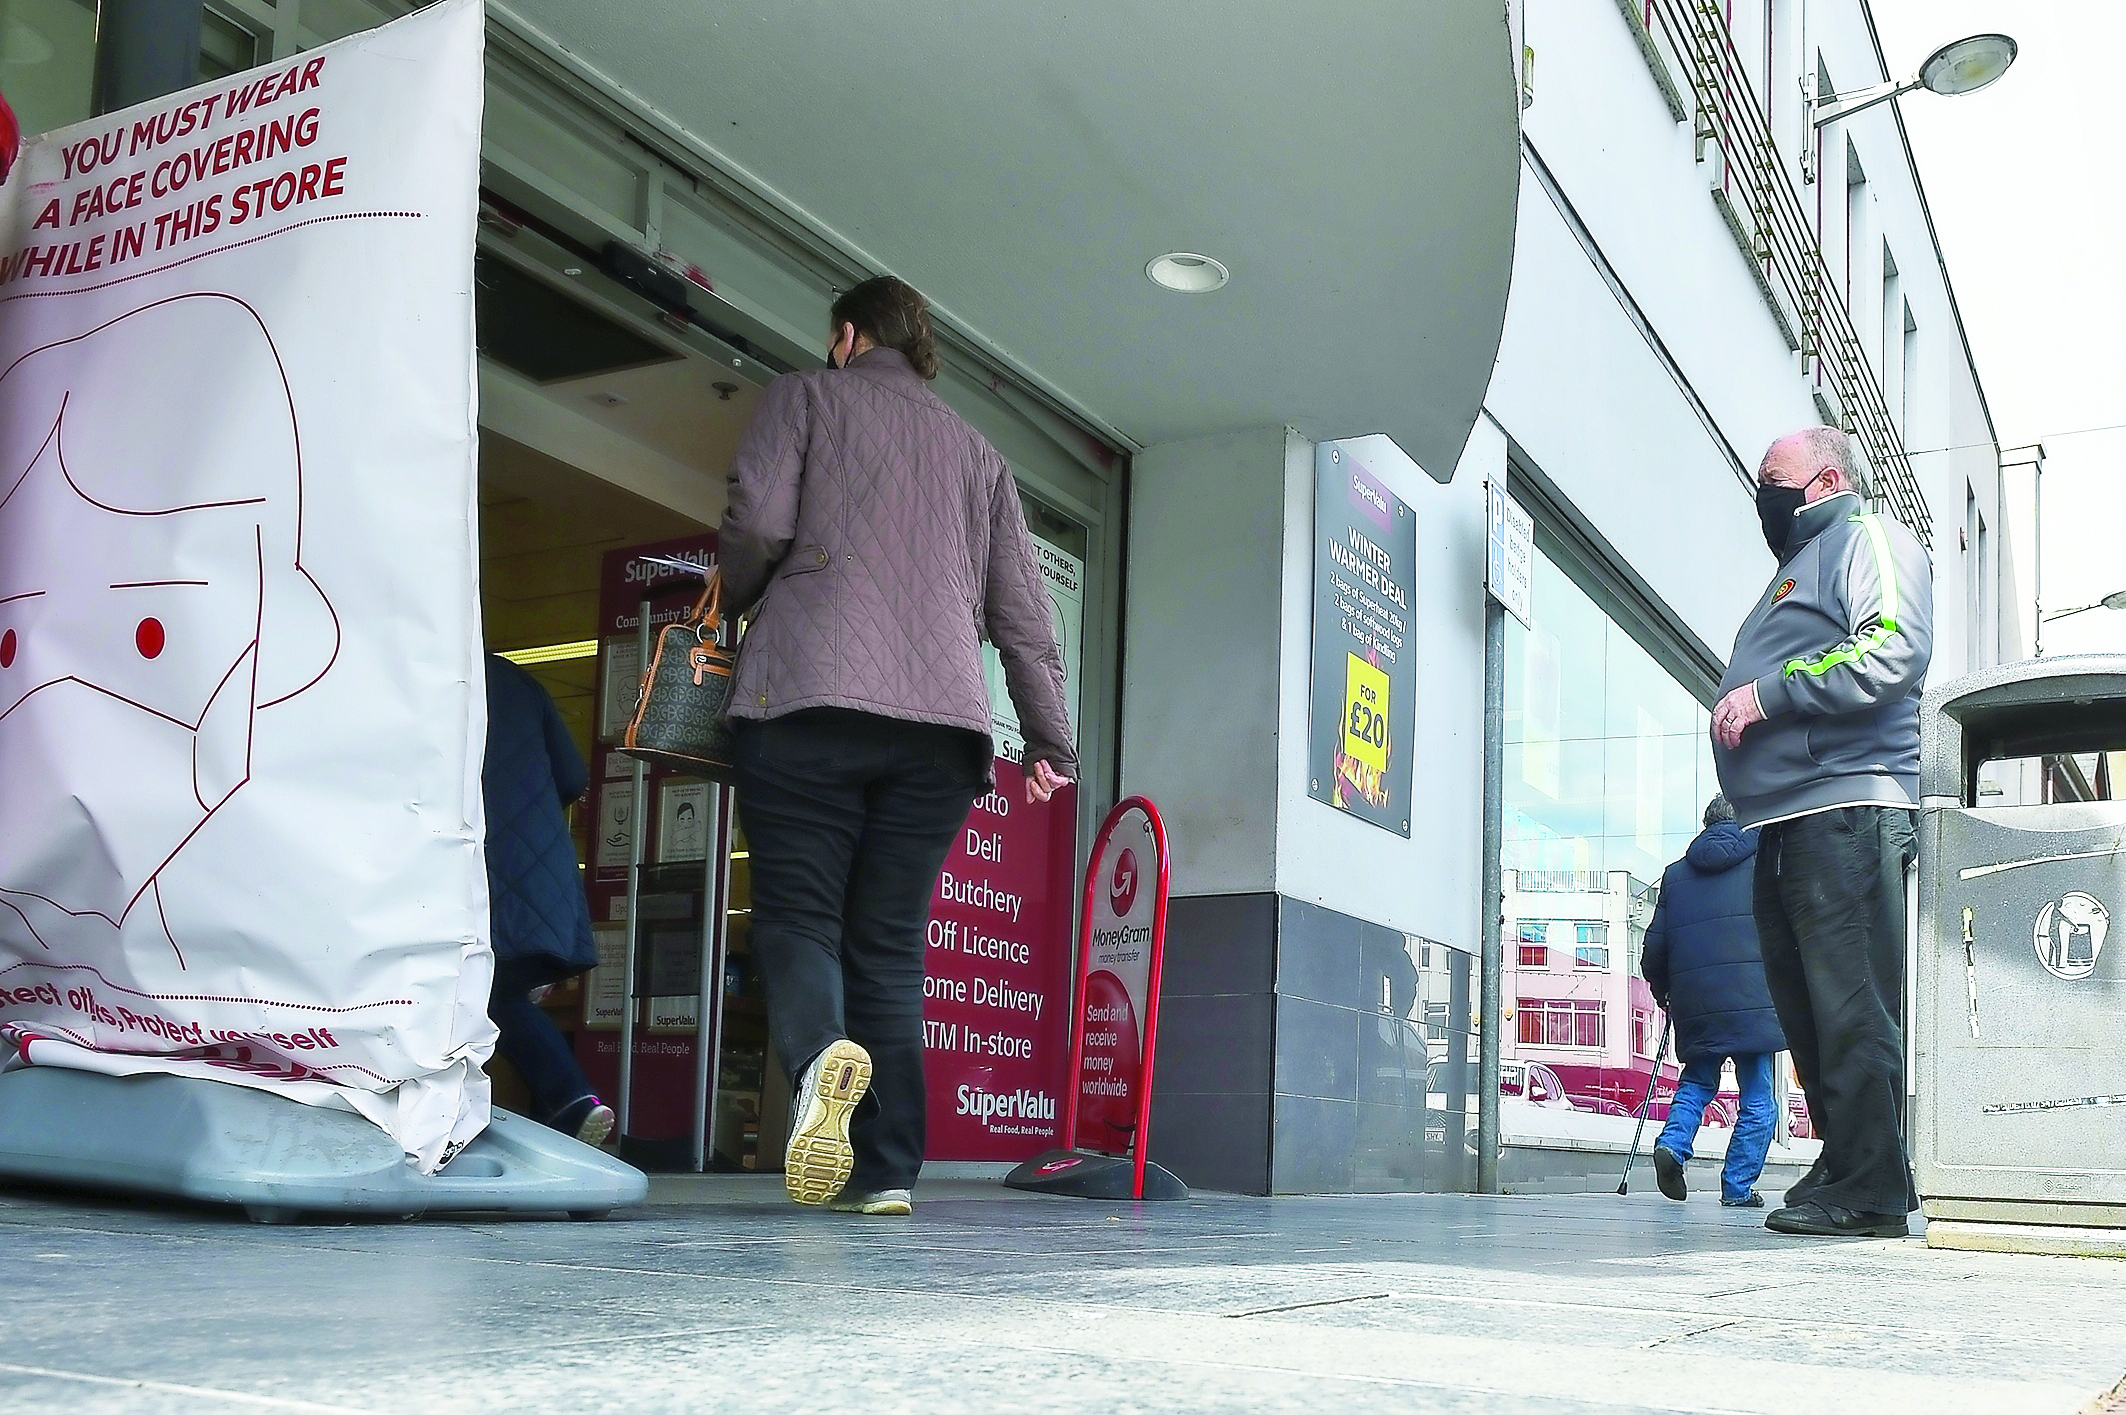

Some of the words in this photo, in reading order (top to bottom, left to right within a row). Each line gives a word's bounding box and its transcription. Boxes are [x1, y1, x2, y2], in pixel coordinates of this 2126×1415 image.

[61, 127, 124, 180] YOU
[129, 95, 222, 157] MUST
[225, 57, 327, 116] WEAR
[32, 198, 60, 230] A
[70, 171, 146, 227] FACE
[151, 107, 322, 199] COVERING
[0, 237, 102, 286] WHILE
[110, 222, 147, 263] IN
[154, 194, 223, 251] THIS
[228, 156, 350, 226] STORE
[1353, 474, 1387, 514] SuperValu
[1043, 549, 1076, 577] OTHERS,
[1348, 525, 1391, 574] WINTER
[1038, 562, 1079, 592] YOURSELF
[1329, 537, 1379, 590] WARMER
[1381, 574, 1408, 610] DEAL
[1330, 571, 1335, 585] 2
[1336, 573, 1351, 595] bags
[1352, 587, 1359, 600] of
[616, 608, 681, 628] Comunity
[1334, 593, 1339, 606] 2
[1340, 596, 1355, 617] bags
[1356, 609, 1363, 621] of
[1353, 623, 1365, 644] bag
[1365, 634, 1373, 647] of
[1360, 684, 1377, 705] FOR
[1350, 701, 1385, 748] £20
[973, 789, 1008, 817] otto
[967, 828, 1002, 862] Deli
[941, 872, 1022, 922] Butchery
[927, 919, 957, 951] Off
[963, 926, 1030, 964] Licence
[1092, 924, 1150, 950] MoneyGram
[922, 976, 967, 1003] ome
[973, 977, 1044, 1021] Delivery
[1086, 1004, 1109, 1022] Send
[1110, 1002, 1128, 1022] and
[116, 1005, 210, 1045] Protect
[656, 1015, 696, 1027] SuperValu
[597, 1041, 616, 1053] Real
[641, 1042, 660, 1054] Real
[661, 1042, 690, 1057] People
[963, 1025, 1032, 1059] In-store
[1085, 1028, 1117, 1046] receive
[1083, 1057, 1114, 1076] money
[1082, 1079, 1128, 1097] worldwide
[956, 1084, 1056, 1125] SuperValu
[989, 1124, 1003, 1133] Real
[1003, 1124, 1020, 1135] Food,
[1021, 1125, 1034, 1135] Real
[1034, 1126, 1054, 1137] People
